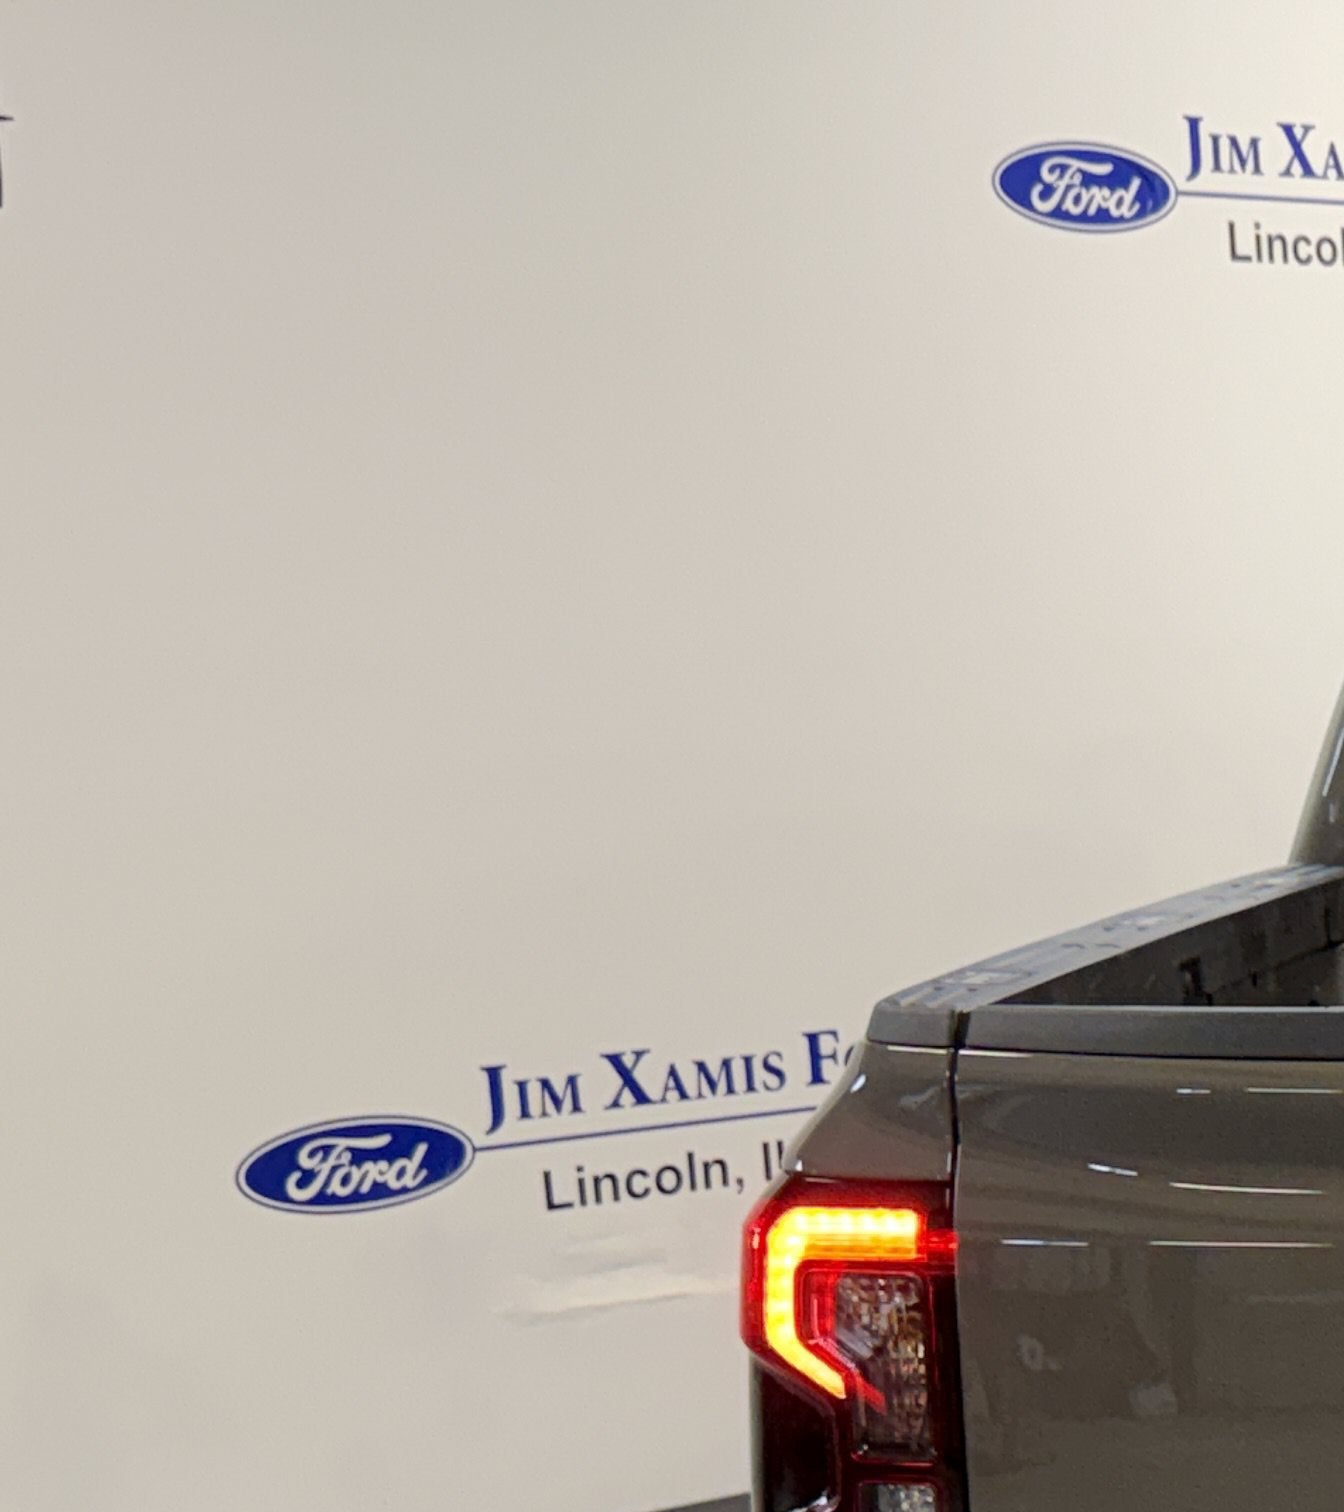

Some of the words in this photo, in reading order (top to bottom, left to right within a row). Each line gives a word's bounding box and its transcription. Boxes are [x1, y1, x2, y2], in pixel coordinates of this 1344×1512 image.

[1030, 155, 1142, 219] Ford
[285, 1133, 428, 1202] Ford
[543, 1150, 745, 1211] Lincoln,
